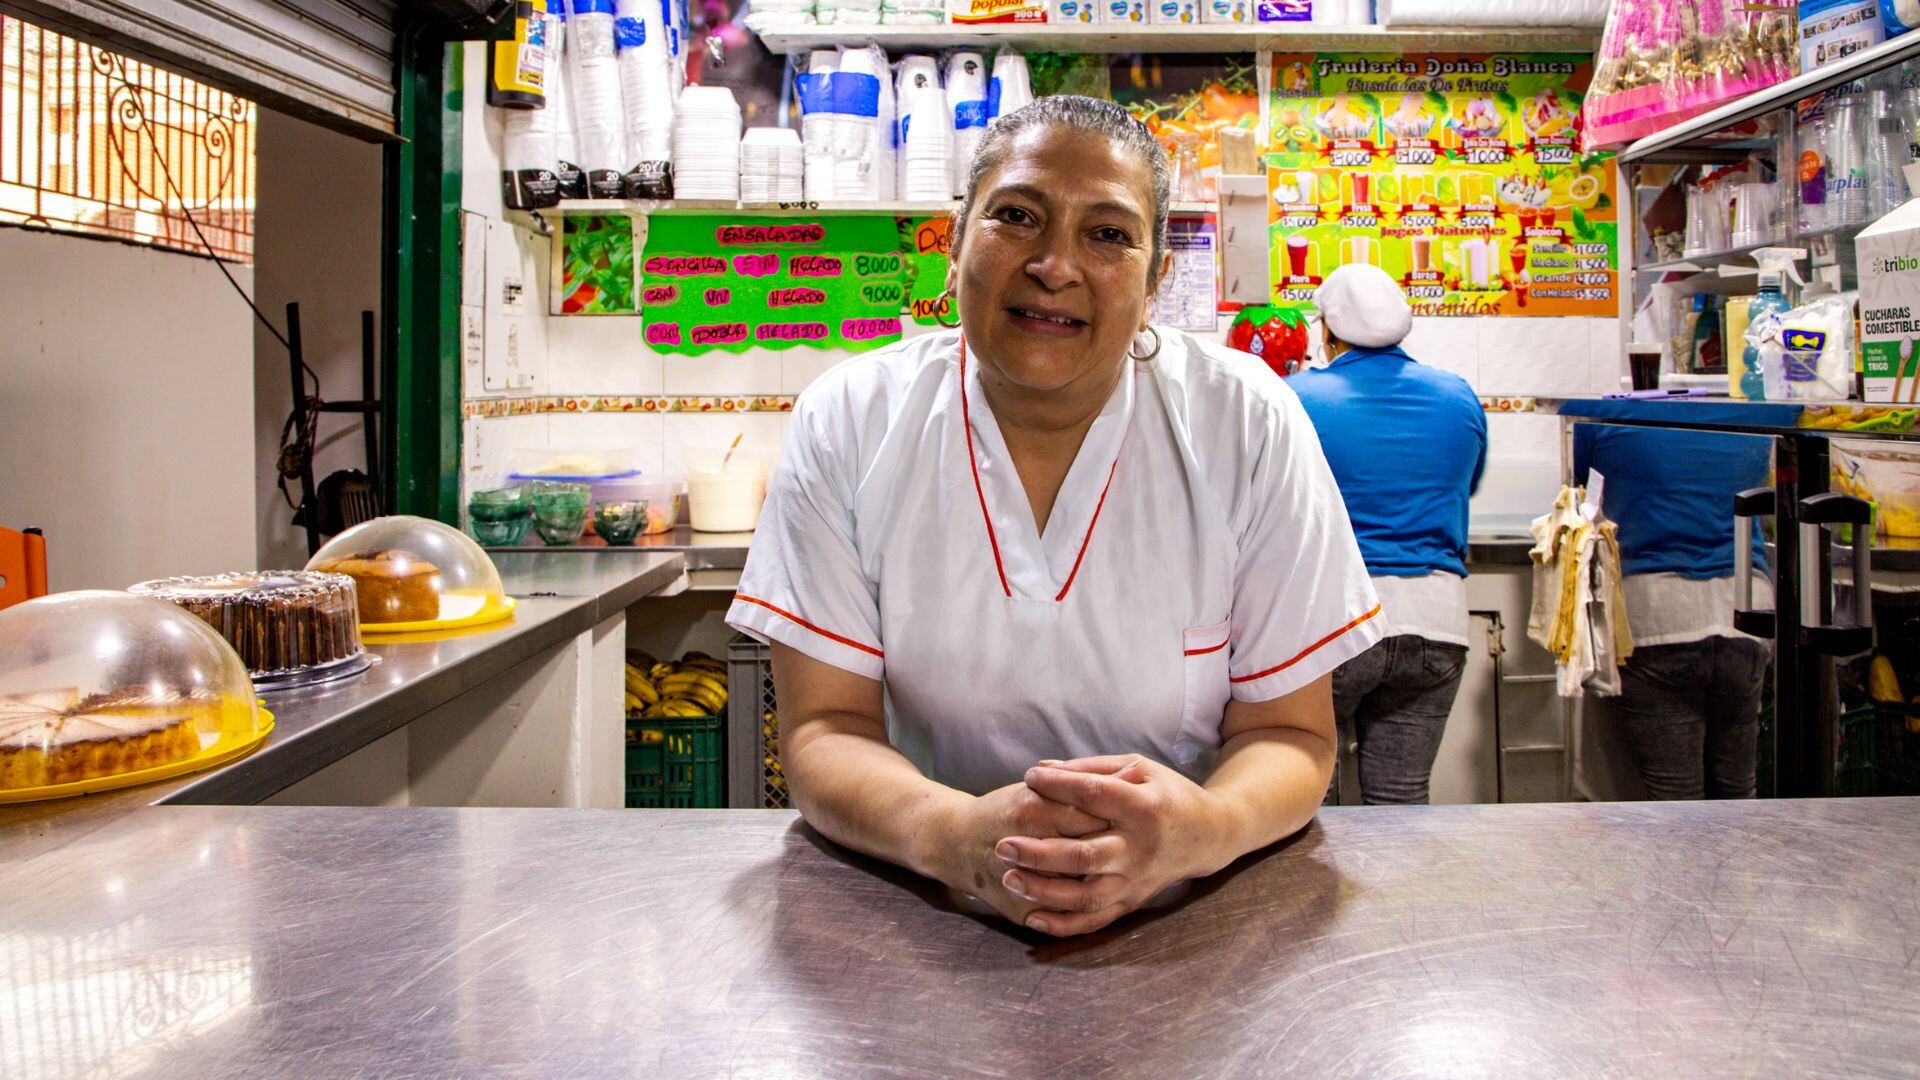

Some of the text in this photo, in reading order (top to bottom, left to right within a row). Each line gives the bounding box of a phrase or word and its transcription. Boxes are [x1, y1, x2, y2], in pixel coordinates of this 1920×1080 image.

[1494, 58, 1574, 77] Blanca
[1347, 75, 1509, 93] Ensaladas De Frutas
[722, 225, 823, 244] ENSALADAS
[1433, 226, 1507, 236] Naturales
[742, 254, 777, 274] SIN
[1884, 254, 1919, 273] tribio
[1534, 273, 1571, 283] Grande
[647, 286, 673, 301] CON
[1411, 295, 1501, 315] nvenidos
[1865, 306, 1911, 322] CUCHARAS
[650, 328, 680, 341] CON
[758, 324, 825, 340] HELADO
[1868, 362, 1888, 371] TRIGO
